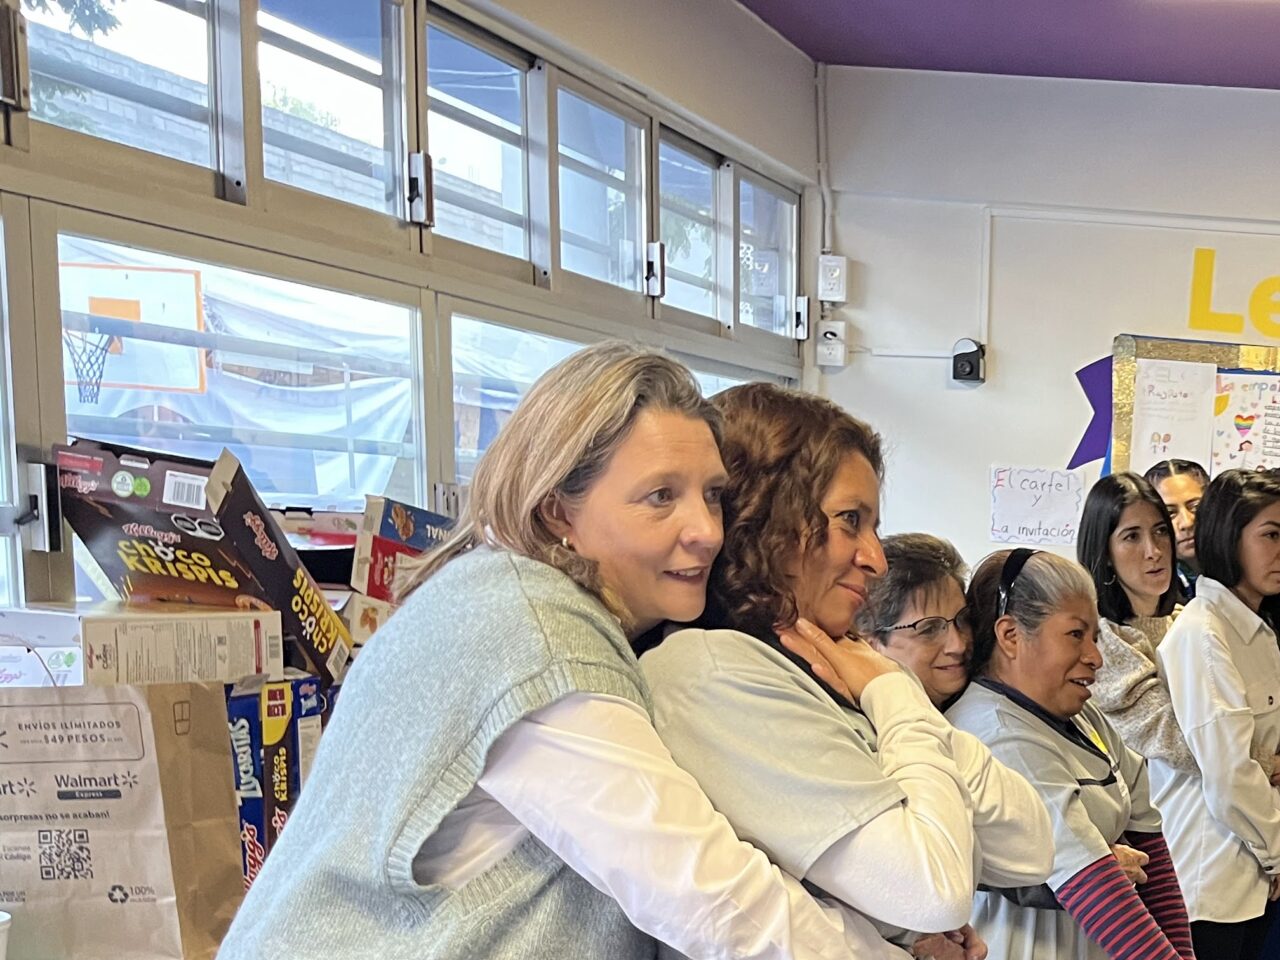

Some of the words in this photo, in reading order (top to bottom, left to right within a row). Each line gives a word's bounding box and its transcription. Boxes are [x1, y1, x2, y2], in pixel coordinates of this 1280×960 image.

[995, 470, 1013, 489] El
[1020, 472, 1070, 493] cartel
[1018, 520, 1075, 537] invitación
[117, 550, 239, 589] KRISPIS
[293, 567, 338, 650] KRISPIS
[67, 733, 107, 744] PESOS
[54, 773, 121, 788] Walmart
[130, 885, 155, 896] 100%
